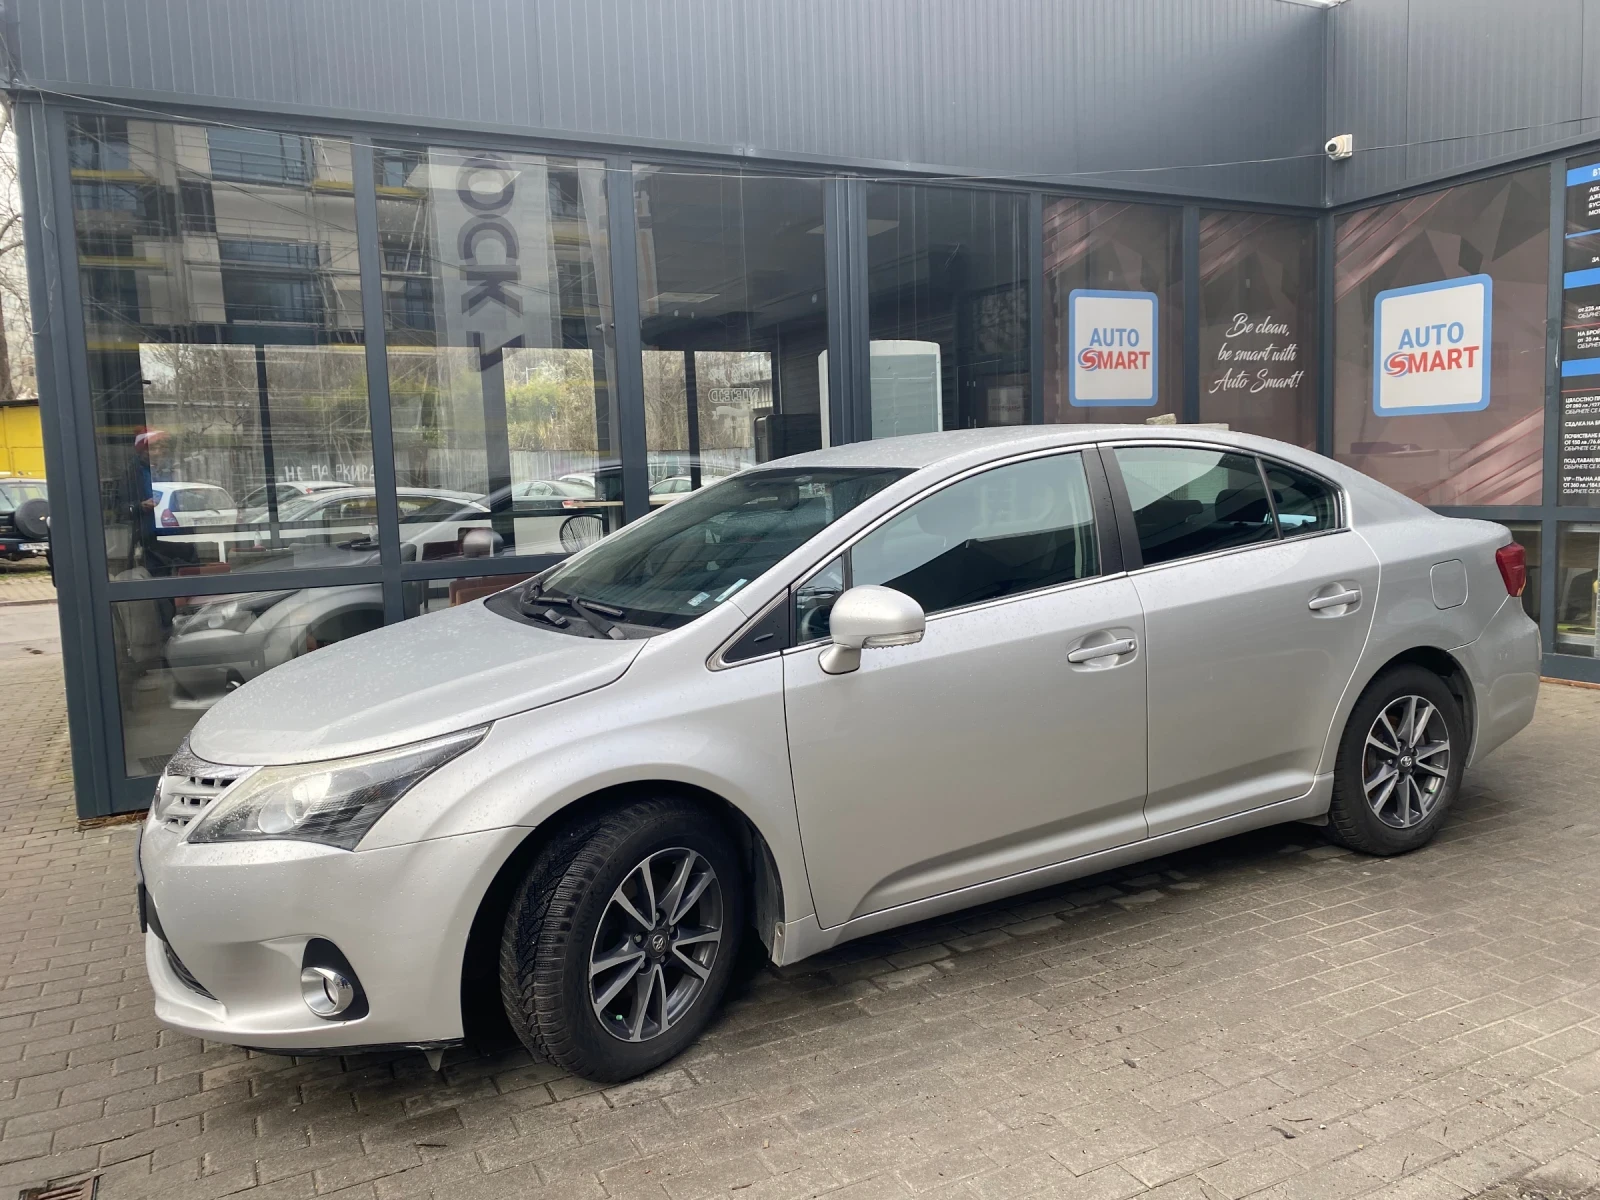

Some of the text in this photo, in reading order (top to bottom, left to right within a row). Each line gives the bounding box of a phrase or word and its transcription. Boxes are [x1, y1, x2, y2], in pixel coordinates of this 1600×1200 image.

[1089, 327, 1140, 347] AUTO
[1226, 312, 1290, 338] Be clean,
[1397, 321, 1464, 350] AUTO
[1078, 347, 1150, 371] SMART
[1217, 342, 1299, 361] be smart with
[1384, 345, 1479, 378] SMART
[1208, 368, 1304, 394] Auto Smart!
